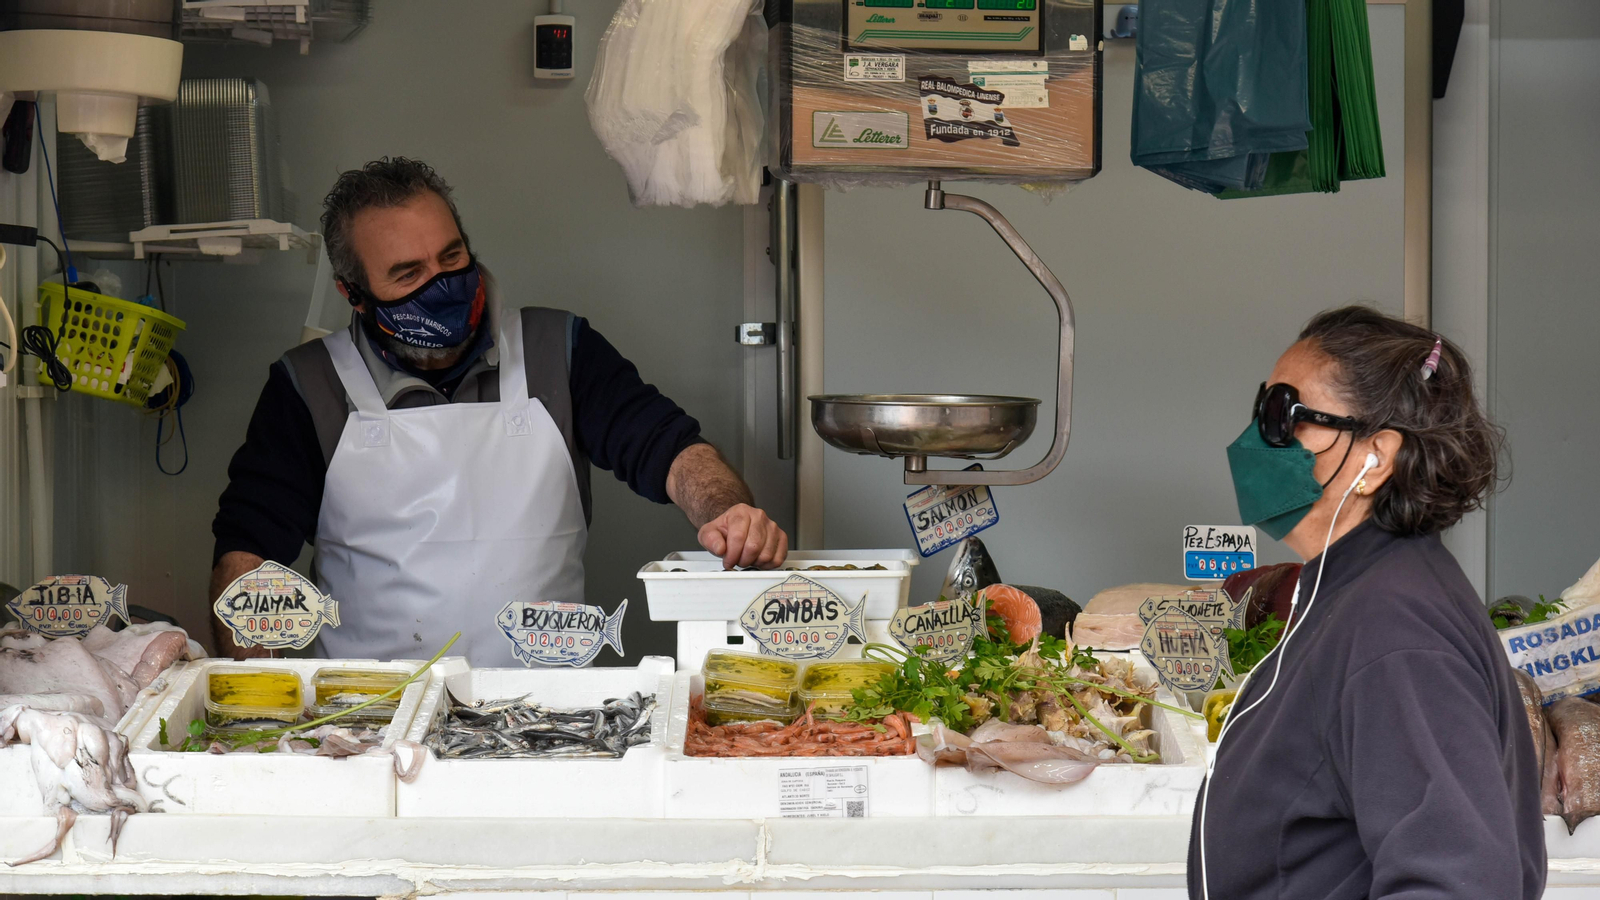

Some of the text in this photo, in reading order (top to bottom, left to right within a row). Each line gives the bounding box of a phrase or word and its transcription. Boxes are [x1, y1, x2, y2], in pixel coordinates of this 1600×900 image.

[866, 13, 896, 23] Letterer
[921, 80, 935, 90] REAL
[936, 82, 976, 99] BALOMPEDICA
[976, 92, 1001, 101] LINENSE
[852, 128, 902, 144] Letterer
[930, 124, 969, 136] Fundada
[392, 313, 420, 323] PESCADOS
[425, 318, 452, 337] MARISCOS
[405, 336, 444, 348] VALLEJO
[521, 607, 606, 632] BOQUERON
[761, 597, 839, 626] GAMBAS
[904, 603, 981, 634] CAÑAILLAS
[1159, 631, 1210, 656] HUEVA
[1508, 613, 1600, 654] ROSADA
[1518, 645, 1600, 678] INGKL
